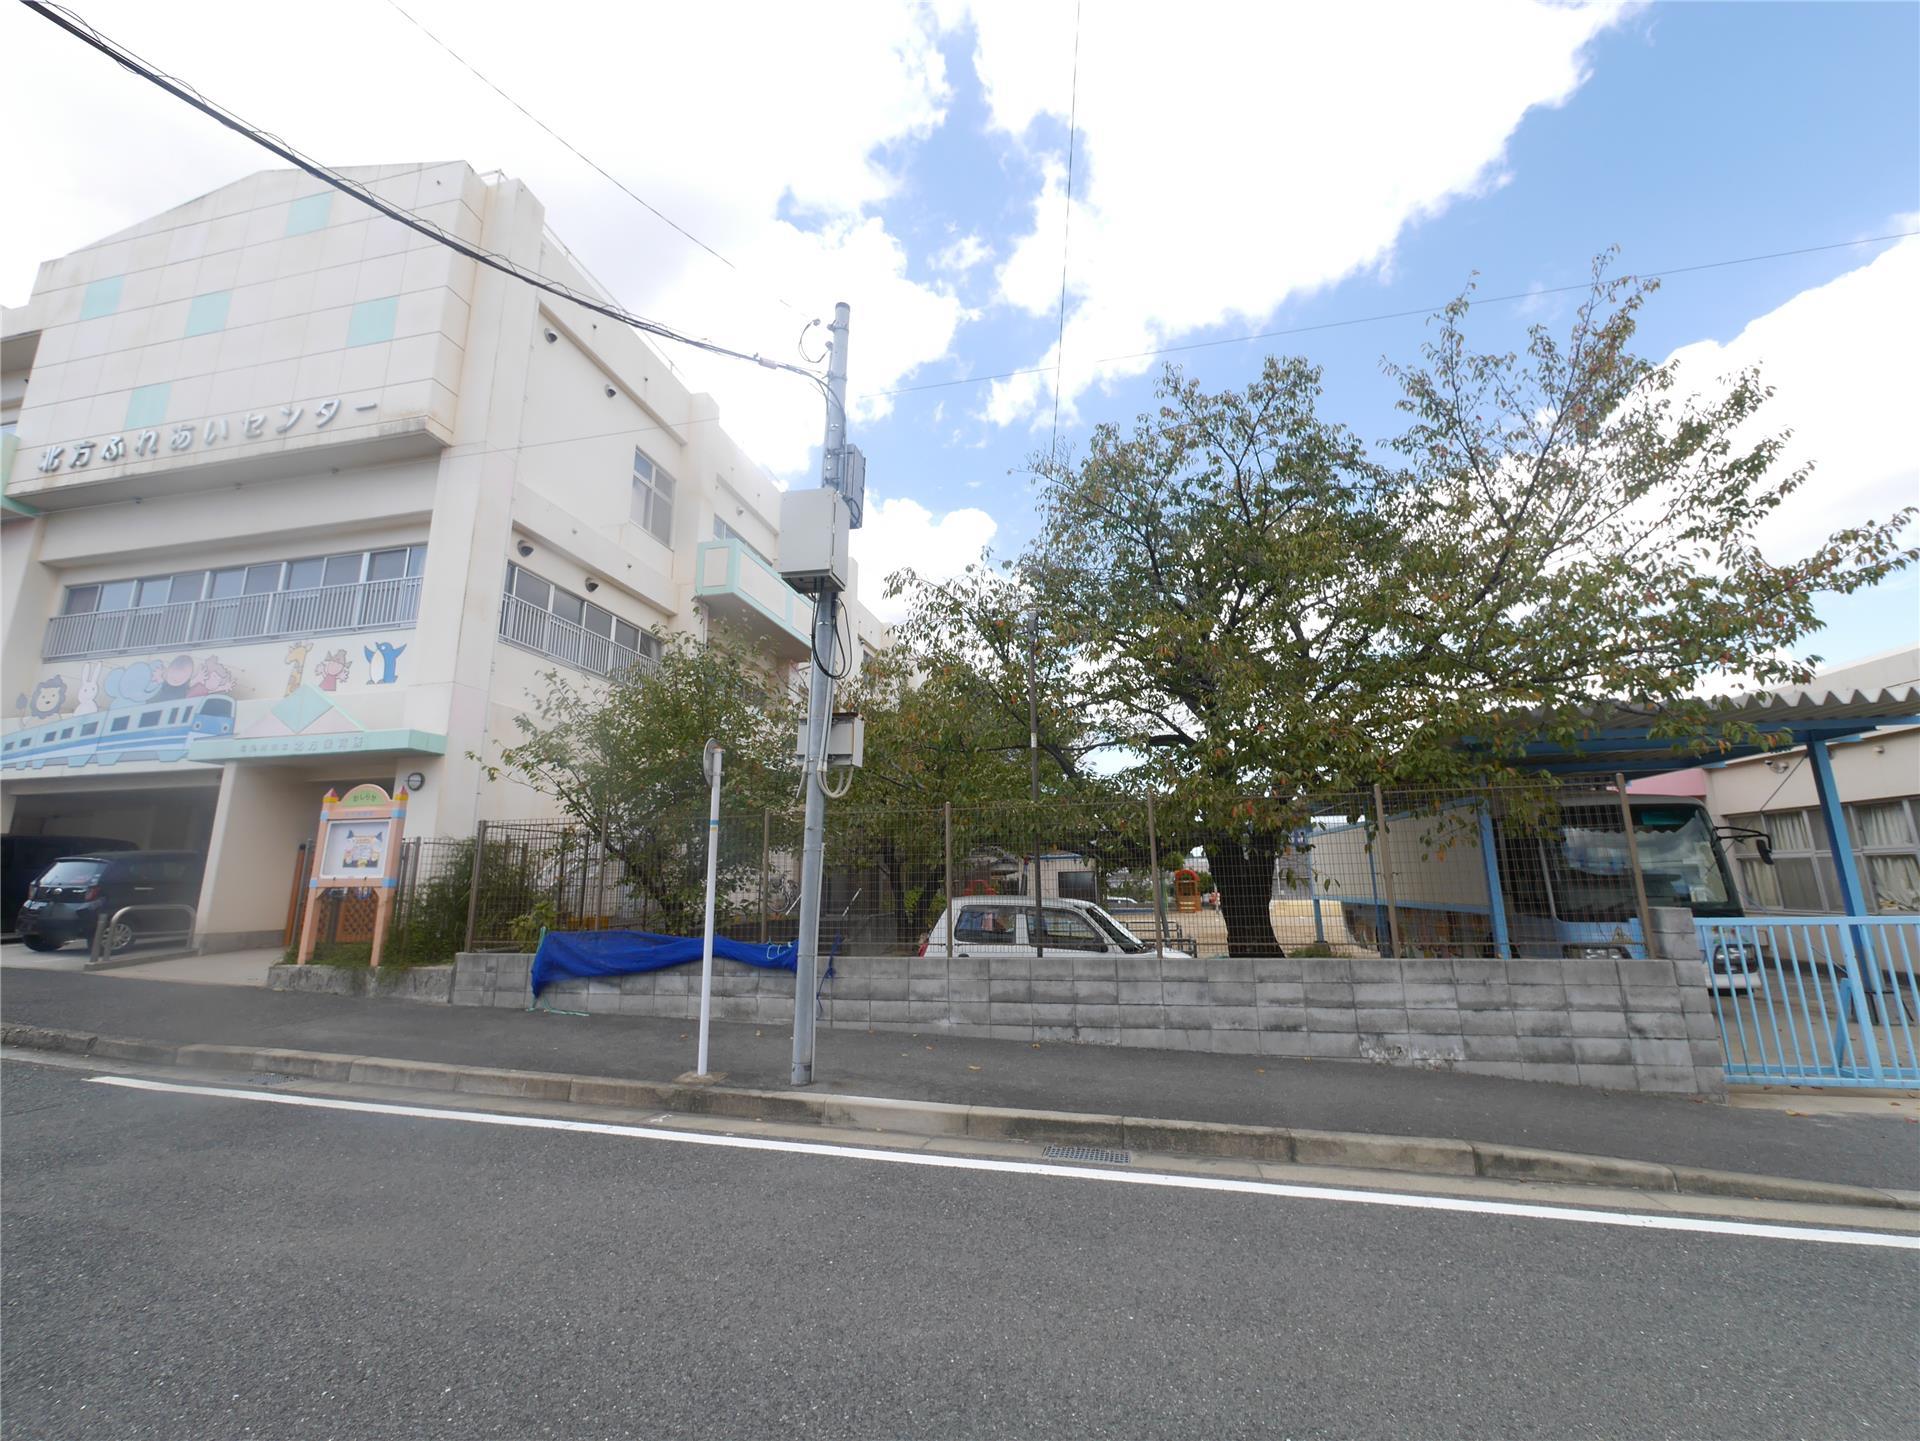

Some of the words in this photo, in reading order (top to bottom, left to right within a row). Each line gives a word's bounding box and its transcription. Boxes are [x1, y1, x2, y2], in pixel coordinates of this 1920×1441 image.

[38, 399, 377, 473] 北方ふれあいセンター
